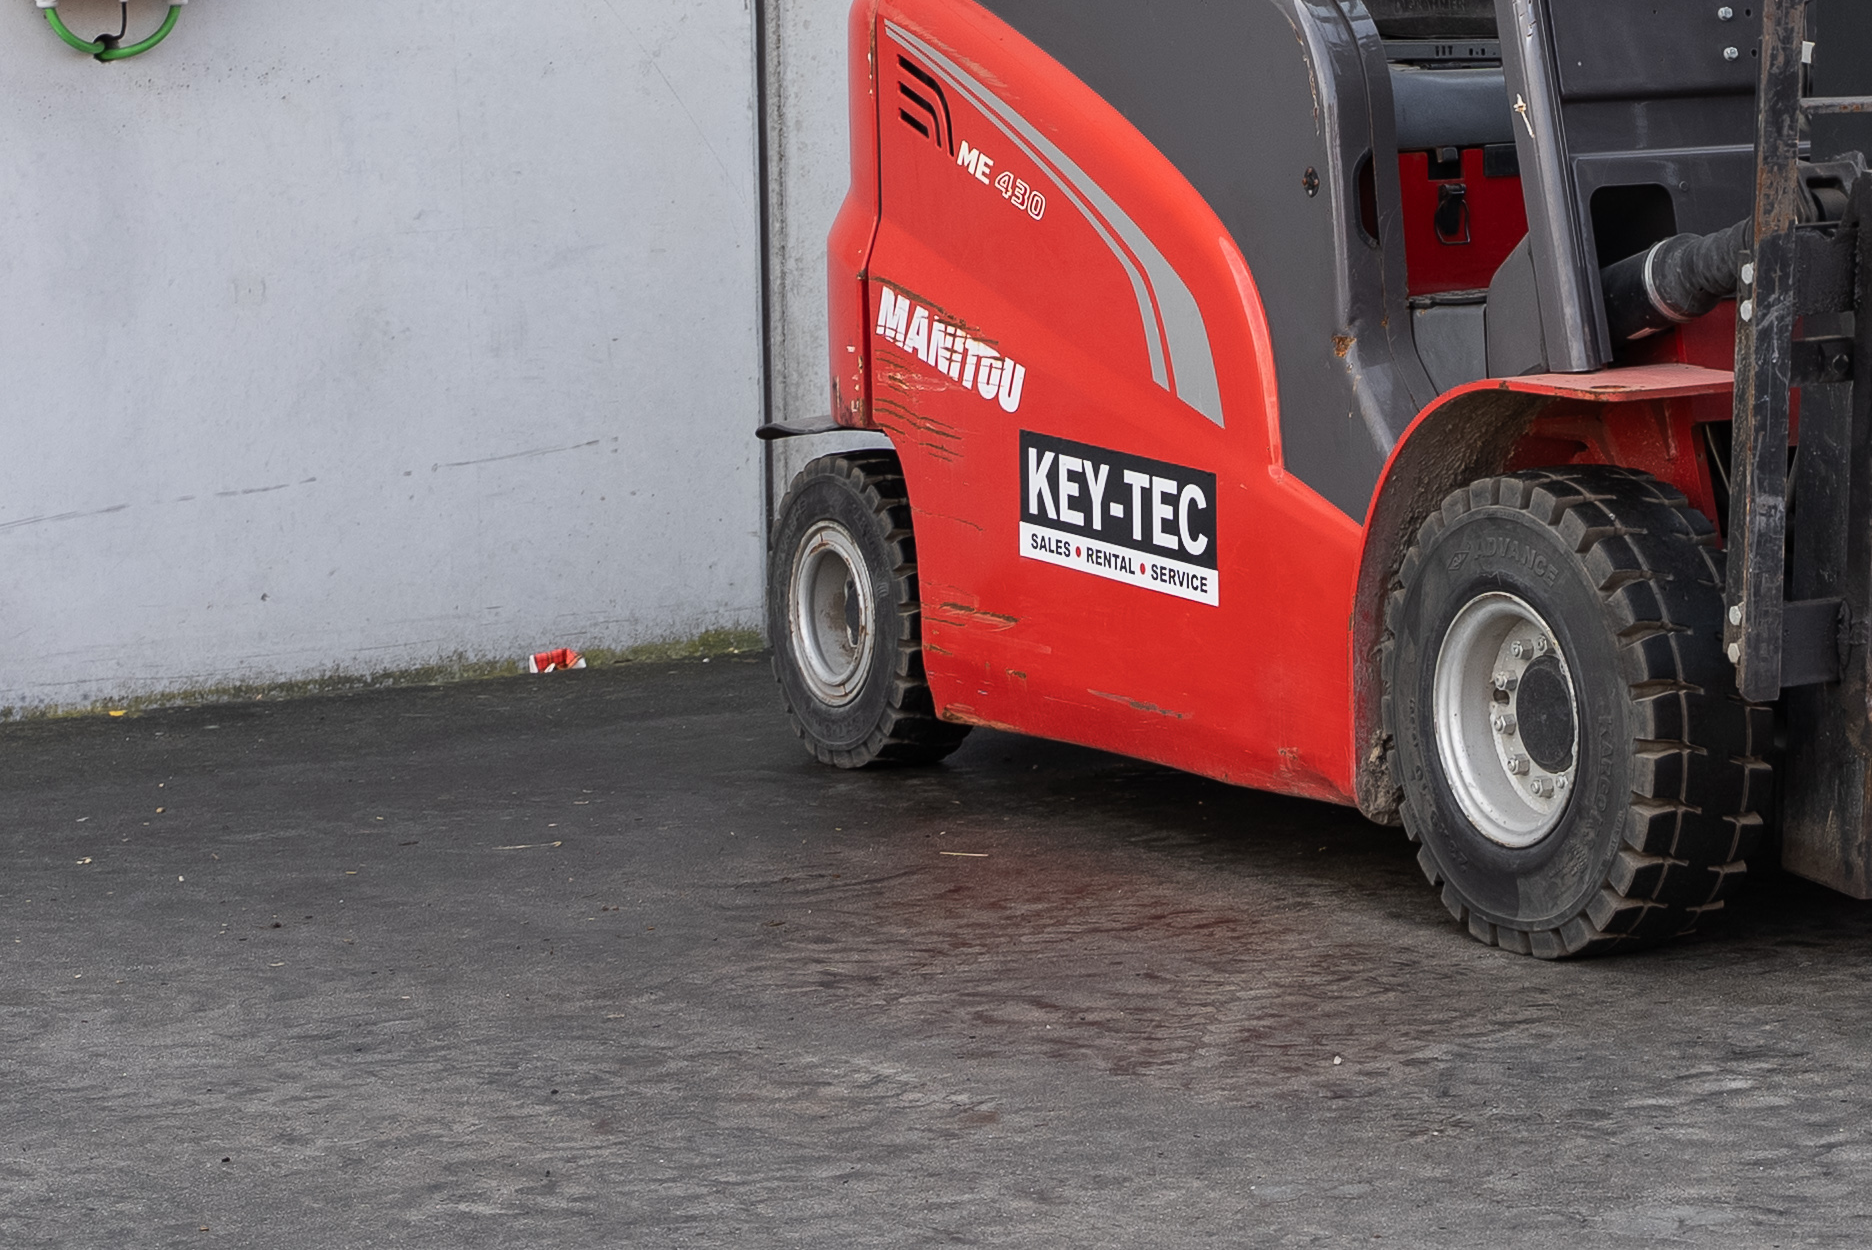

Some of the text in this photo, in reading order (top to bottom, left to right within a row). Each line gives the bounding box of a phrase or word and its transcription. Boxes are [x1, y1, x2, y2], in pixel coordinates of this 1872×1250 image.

[957, 140, 1046, 221] ME 430
[875, 285, 1026, 413] MANITOU
[1028, 447, 1208, 556] KEY-TEC
[1031, 533, 1208, 594] SALES RENTAL SERVICE
[1474, 536, 1559, 588] ADVANCE
